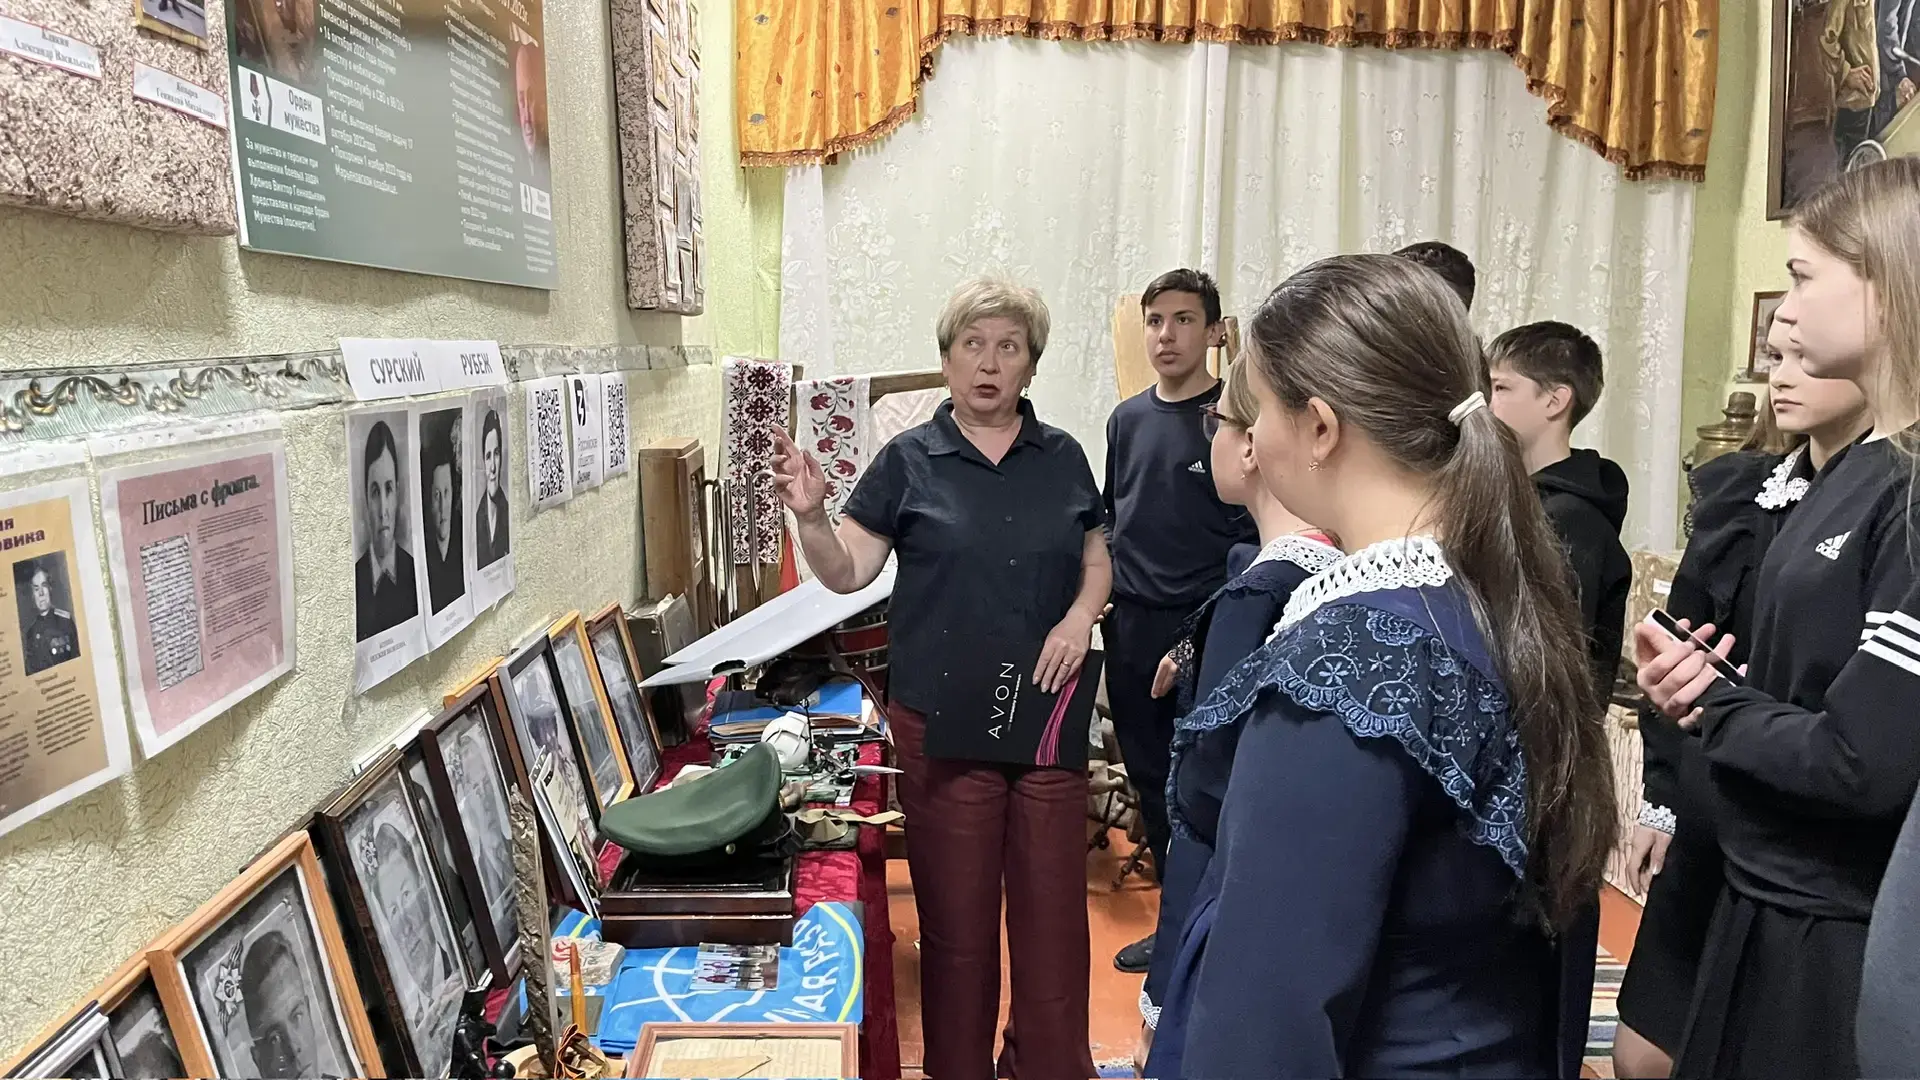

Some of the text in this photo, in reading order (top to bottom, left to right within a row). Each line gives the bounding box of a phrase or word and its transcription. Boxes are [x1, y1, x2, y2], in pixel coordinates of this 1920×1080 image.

[289, 89, 312, 112] Орден
[284, 111, 320, 136] мужества
[245, 138, 253, 149] За
[370, 351, 493, 384] СУРСКИЙ РУБЕЖ
[142, 493, 198, 526] Письма
[200, 489, 209, 506] с
[0, 529, 45, 552] вика
[988, 663, 1015, 739] AVON
